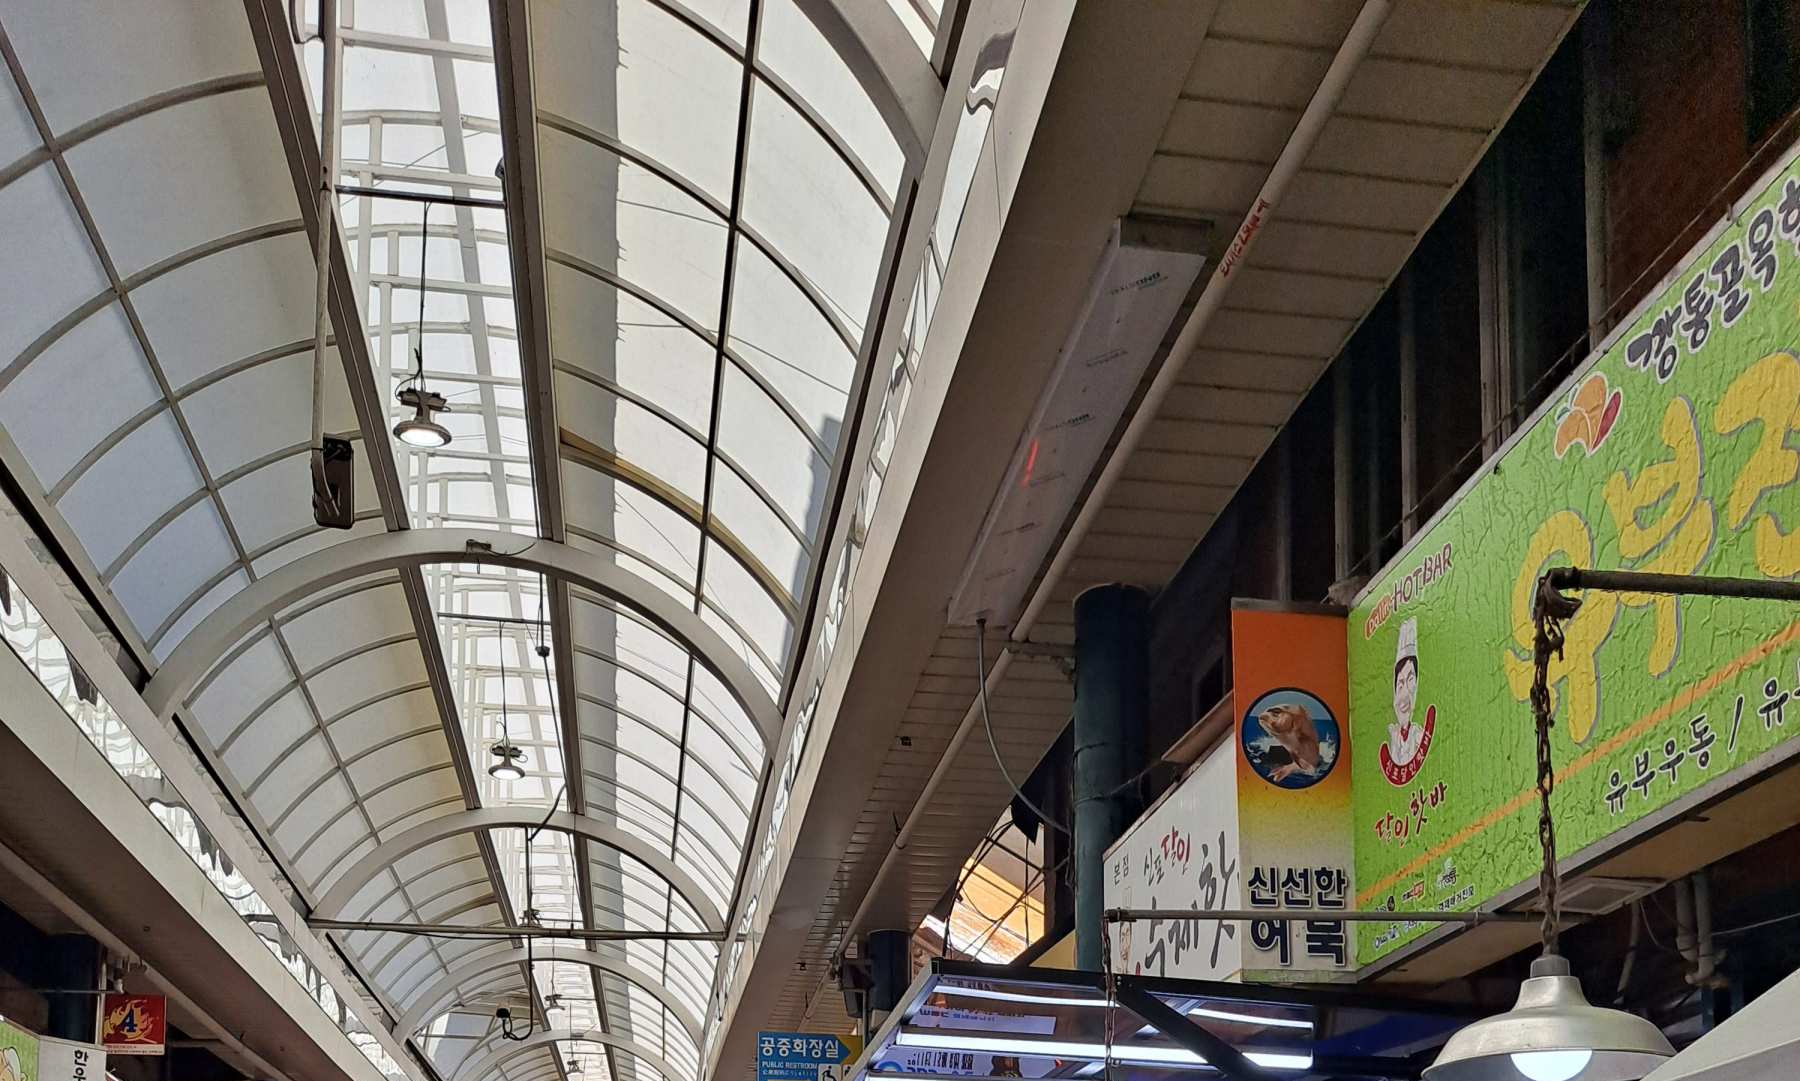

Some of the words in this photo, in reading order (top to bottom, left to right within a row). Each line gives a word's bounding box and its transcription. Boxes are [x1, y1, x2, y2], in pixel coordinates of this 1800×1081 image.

[1605, 714, 1718, 815] 유부우동
[1759, 672, 1800, 730] 유
[1375, 811, 1409, 849] 달인
[1410, 781, 1447, 835] 핫바
[1113, 852, 1129, 886] 본점
[1160, 825, 1191, 875] 달인
[1248, 866, 1347, 907] 신선한
[760, 1037, 839, 1058] 공중화장실
[761, 1061, 784, 1069] PUBLIC
[785, 1061, 817, 1069] RESTROOM
